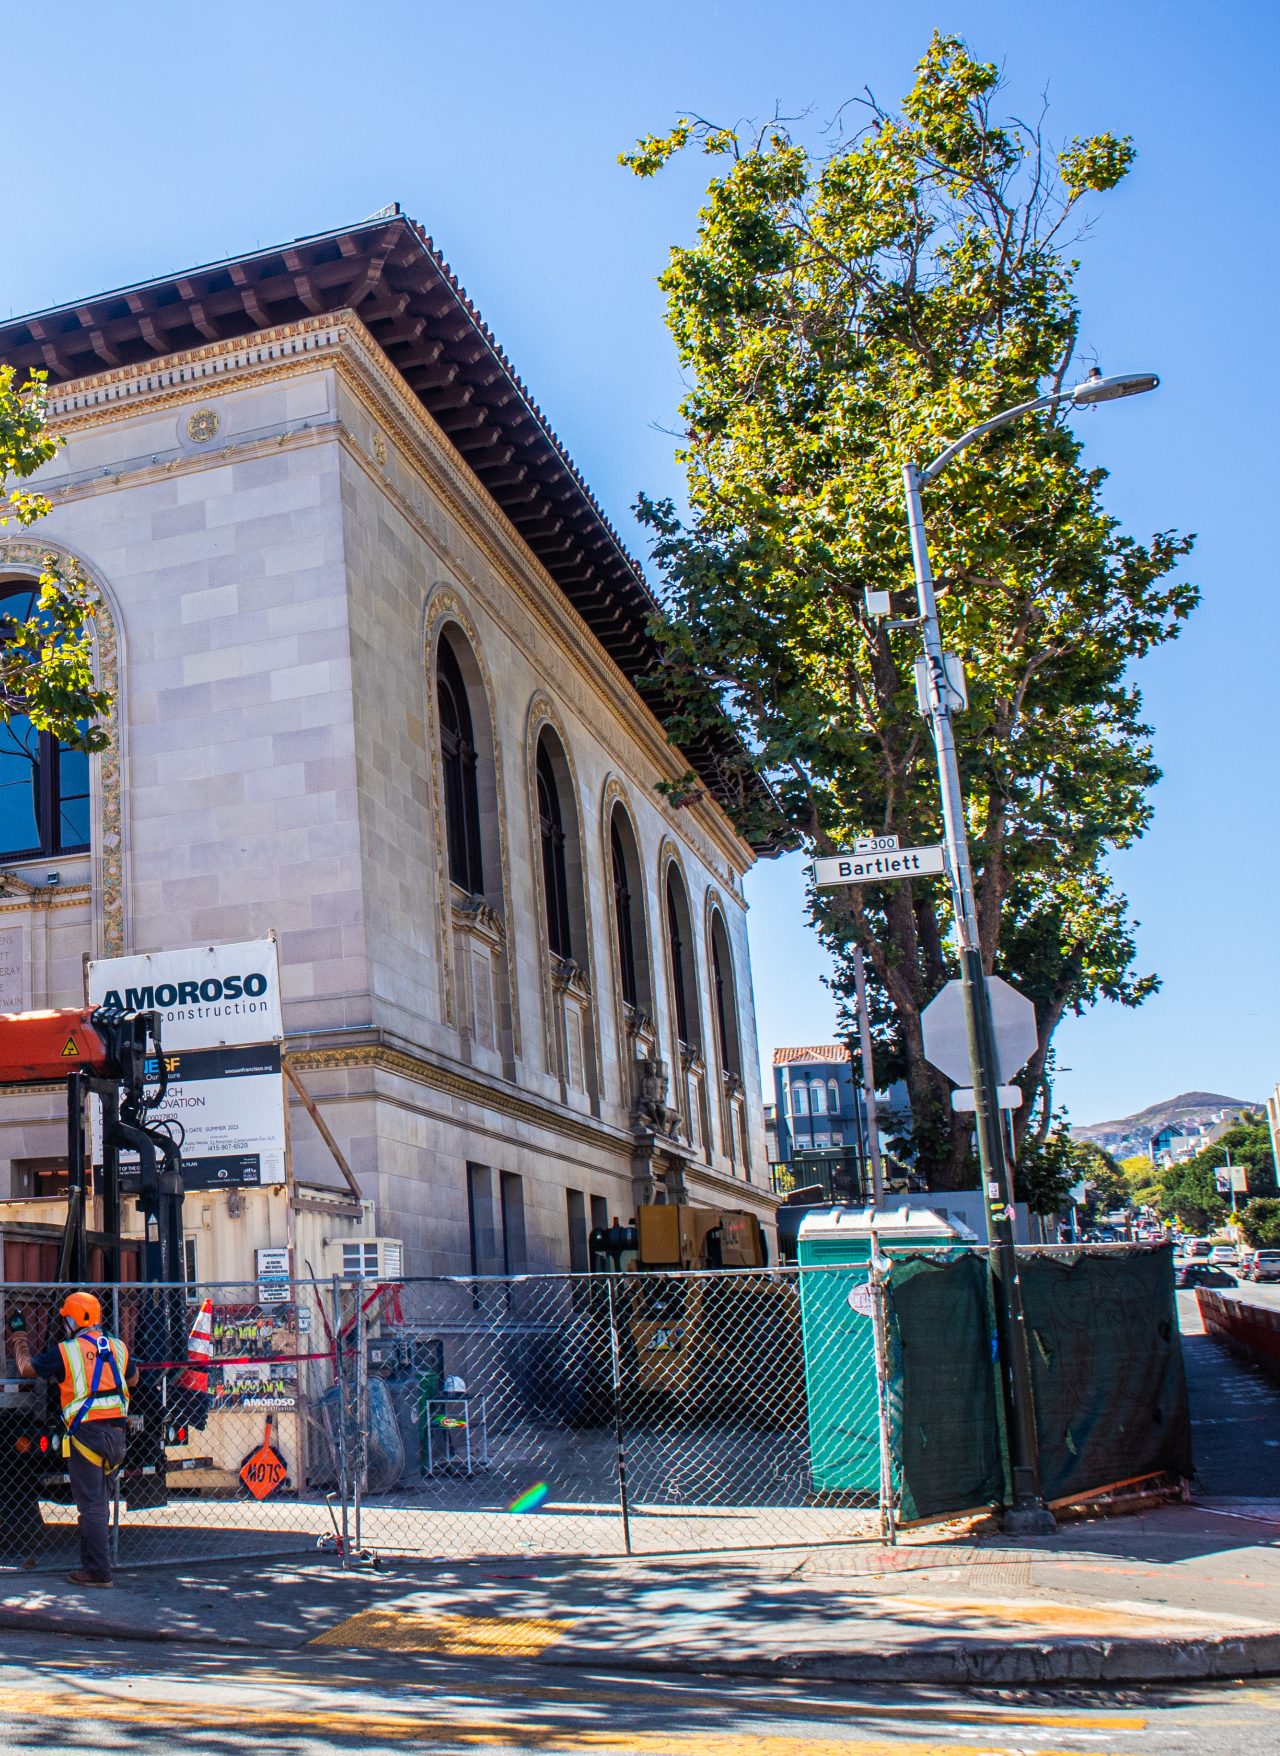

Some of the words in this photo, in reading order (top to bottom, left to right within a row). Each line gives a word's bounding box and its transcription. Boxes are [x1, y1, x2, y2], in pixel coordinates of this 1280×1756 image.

[870, 838, 895, 850] 300
[838, 854, 920, 877] Bartlett
[102, 973, 268, 1010] AMOROSO
[224, 1066, 272, 1074] onesanfrancisco.org
[243, 1398, 295, 1407] AMOROSO
[246, 1463, 281, 1483] SLOW
